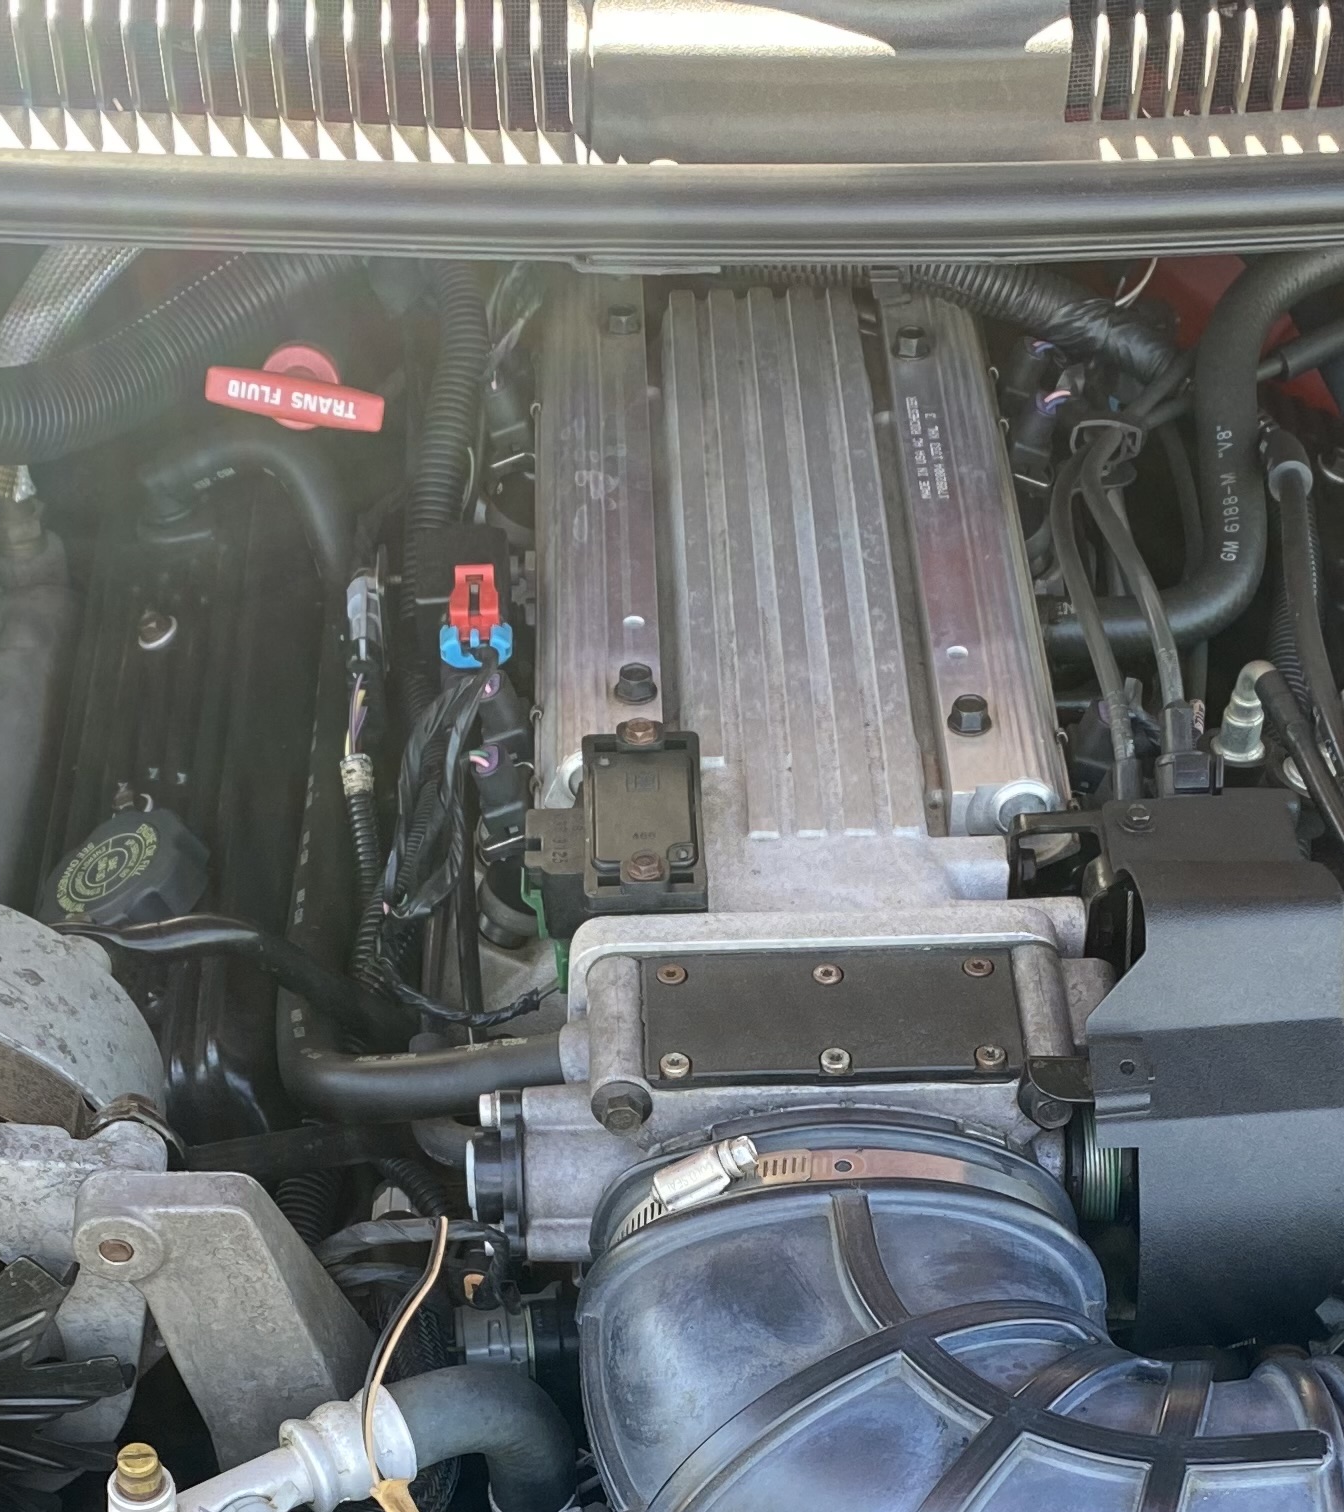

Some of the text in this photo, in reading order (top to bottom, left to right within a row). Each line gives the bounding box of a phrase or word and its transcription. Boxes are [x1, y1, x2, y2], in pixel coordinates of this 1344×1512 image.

[227, 379, 356, 419] TRANS FLUID
[1220, 541, 1240, 561] GM
